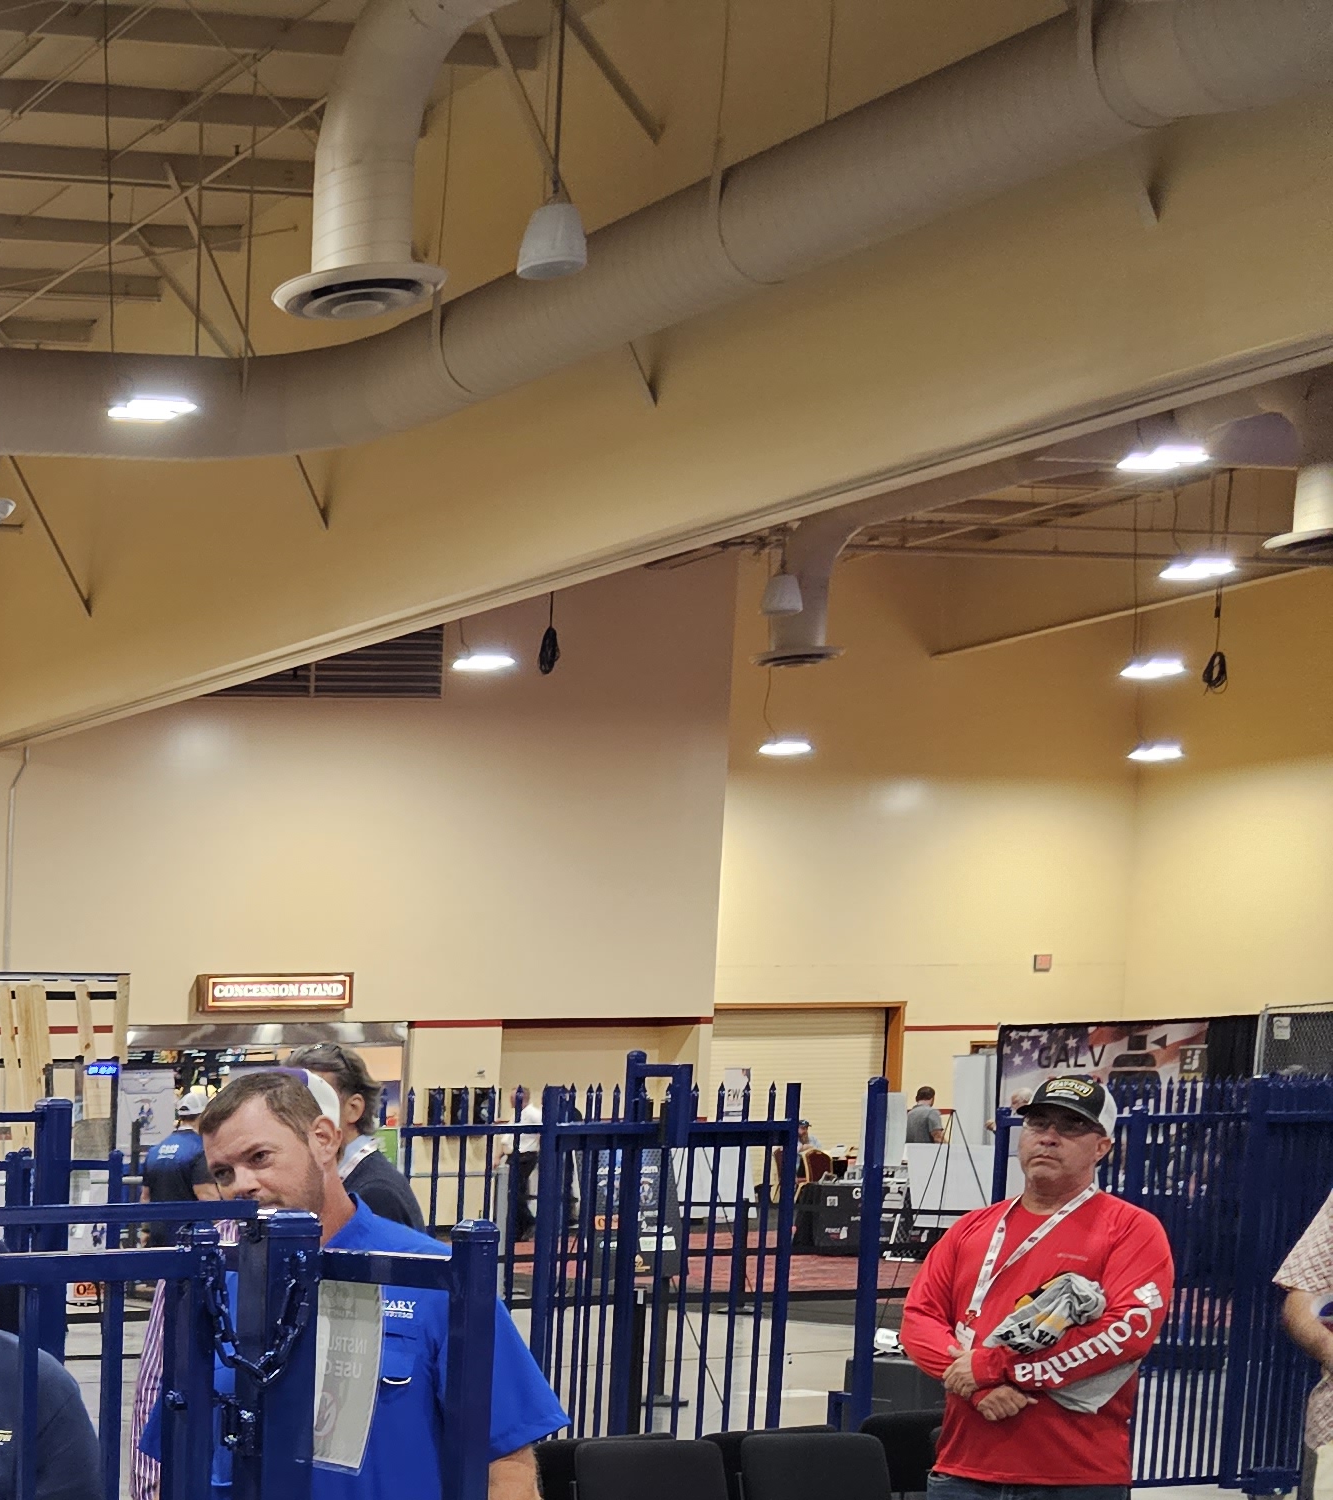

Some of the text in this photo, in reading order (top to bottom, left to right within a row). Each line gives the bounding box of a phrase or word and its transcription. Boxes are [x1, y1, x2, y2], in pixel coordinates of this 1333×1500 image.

[214, 983, 343, 997] CONCESSION STAND
[1013, 1306, 1153, 1388] Columbia
